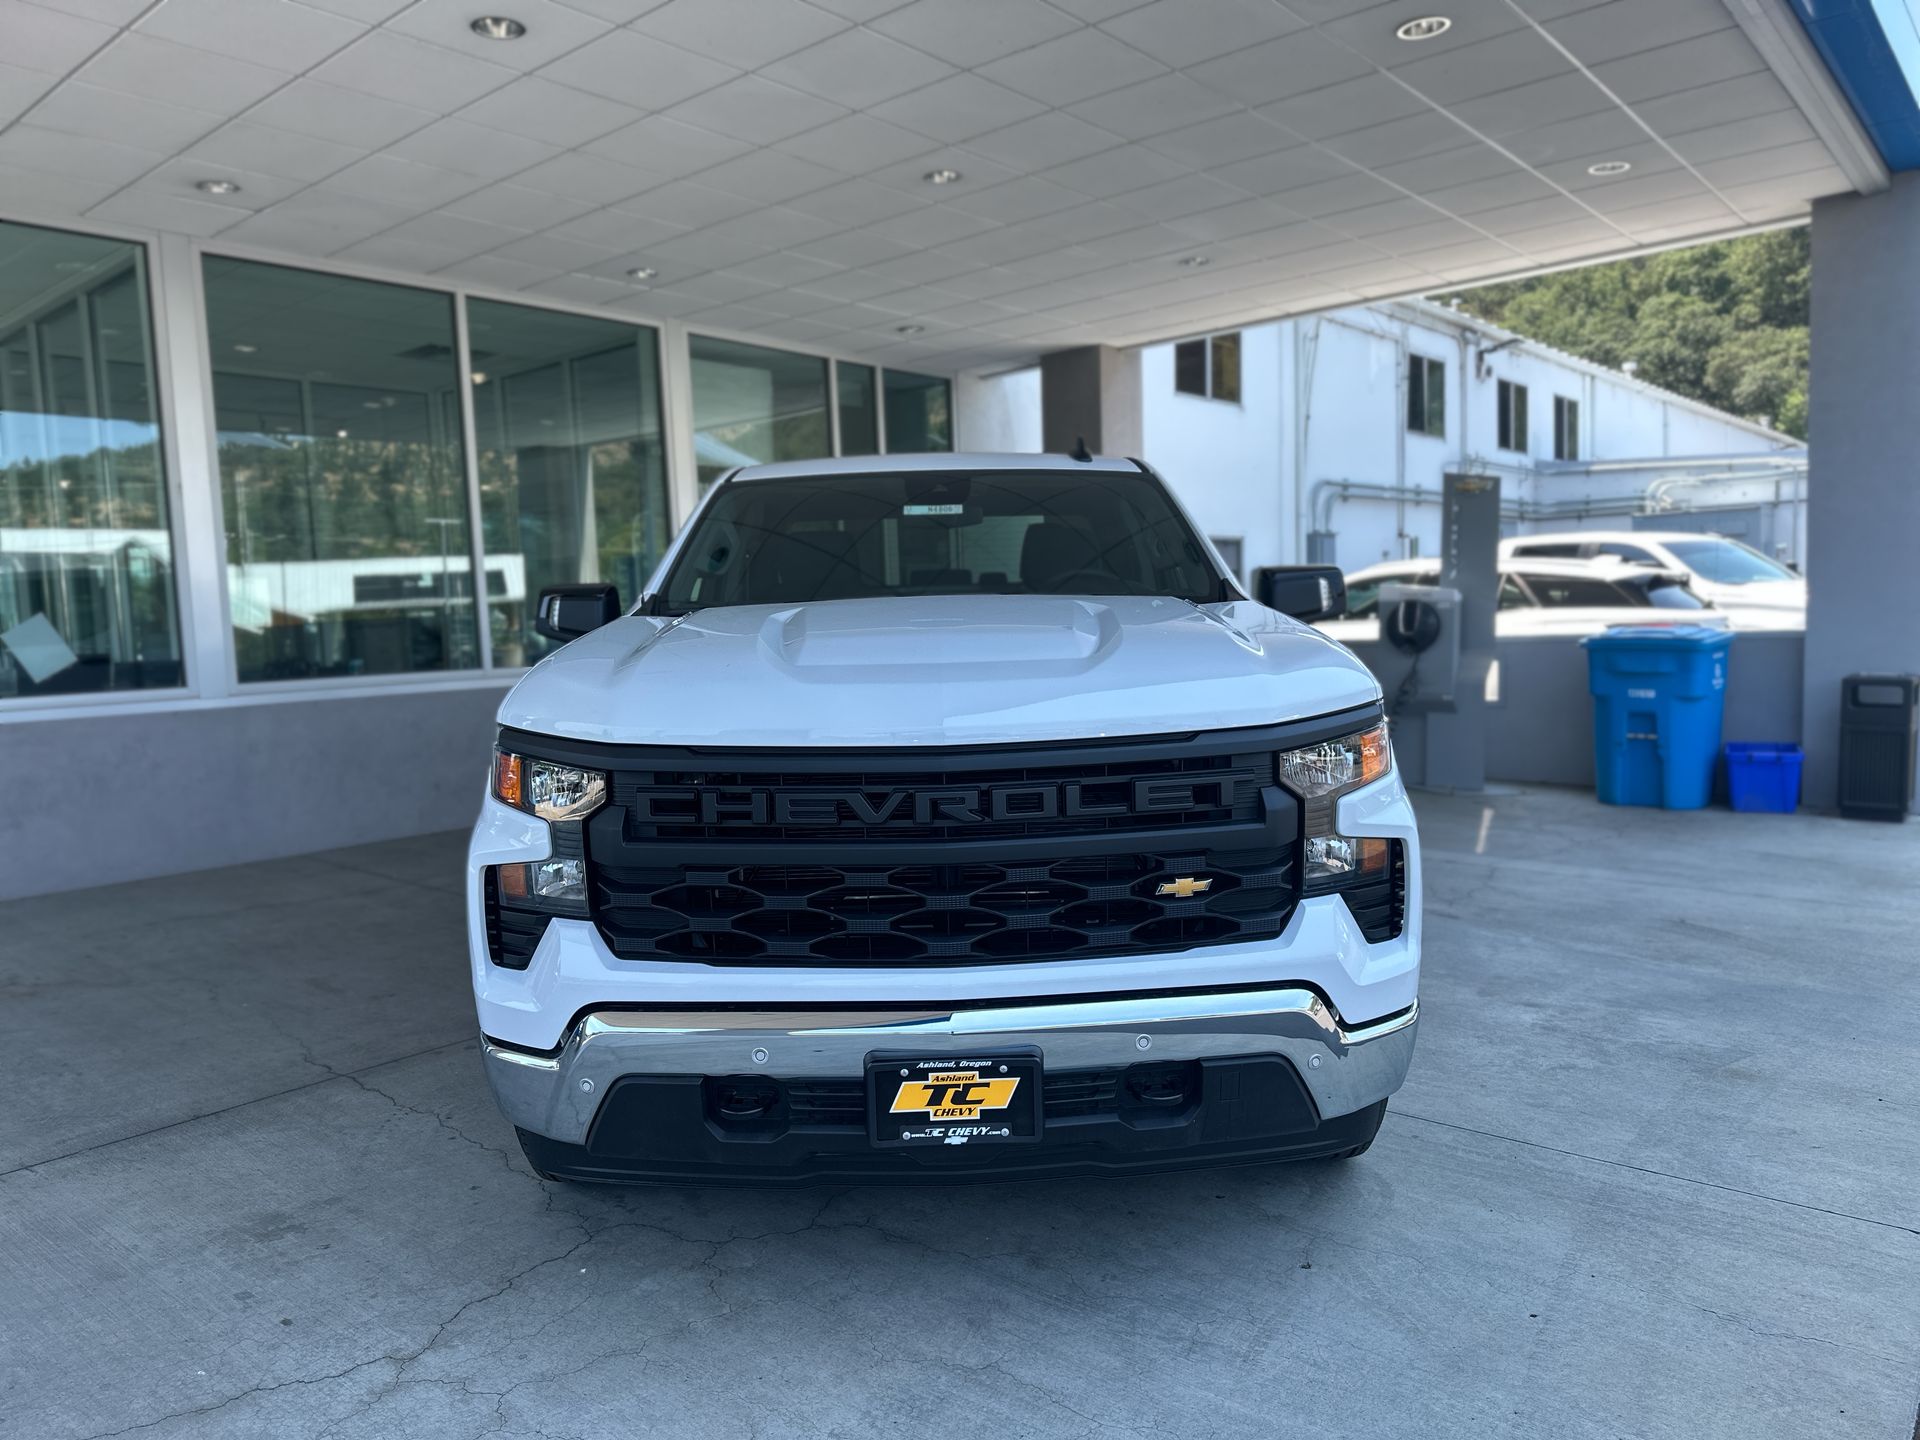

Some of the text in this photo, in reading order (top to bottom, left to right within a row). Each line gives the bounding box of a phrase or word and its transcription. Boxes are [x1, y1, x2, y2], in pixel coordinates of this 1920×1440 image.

[636, 773, 1255, 823] CHEVROLET
[916, 1061, 957, 1069] Ashland,
[932, 1074, 975, 1082] Ashland
[922, 1082, 990, 1106] TC
[933, 1107, 976, 1116] CHEVY
